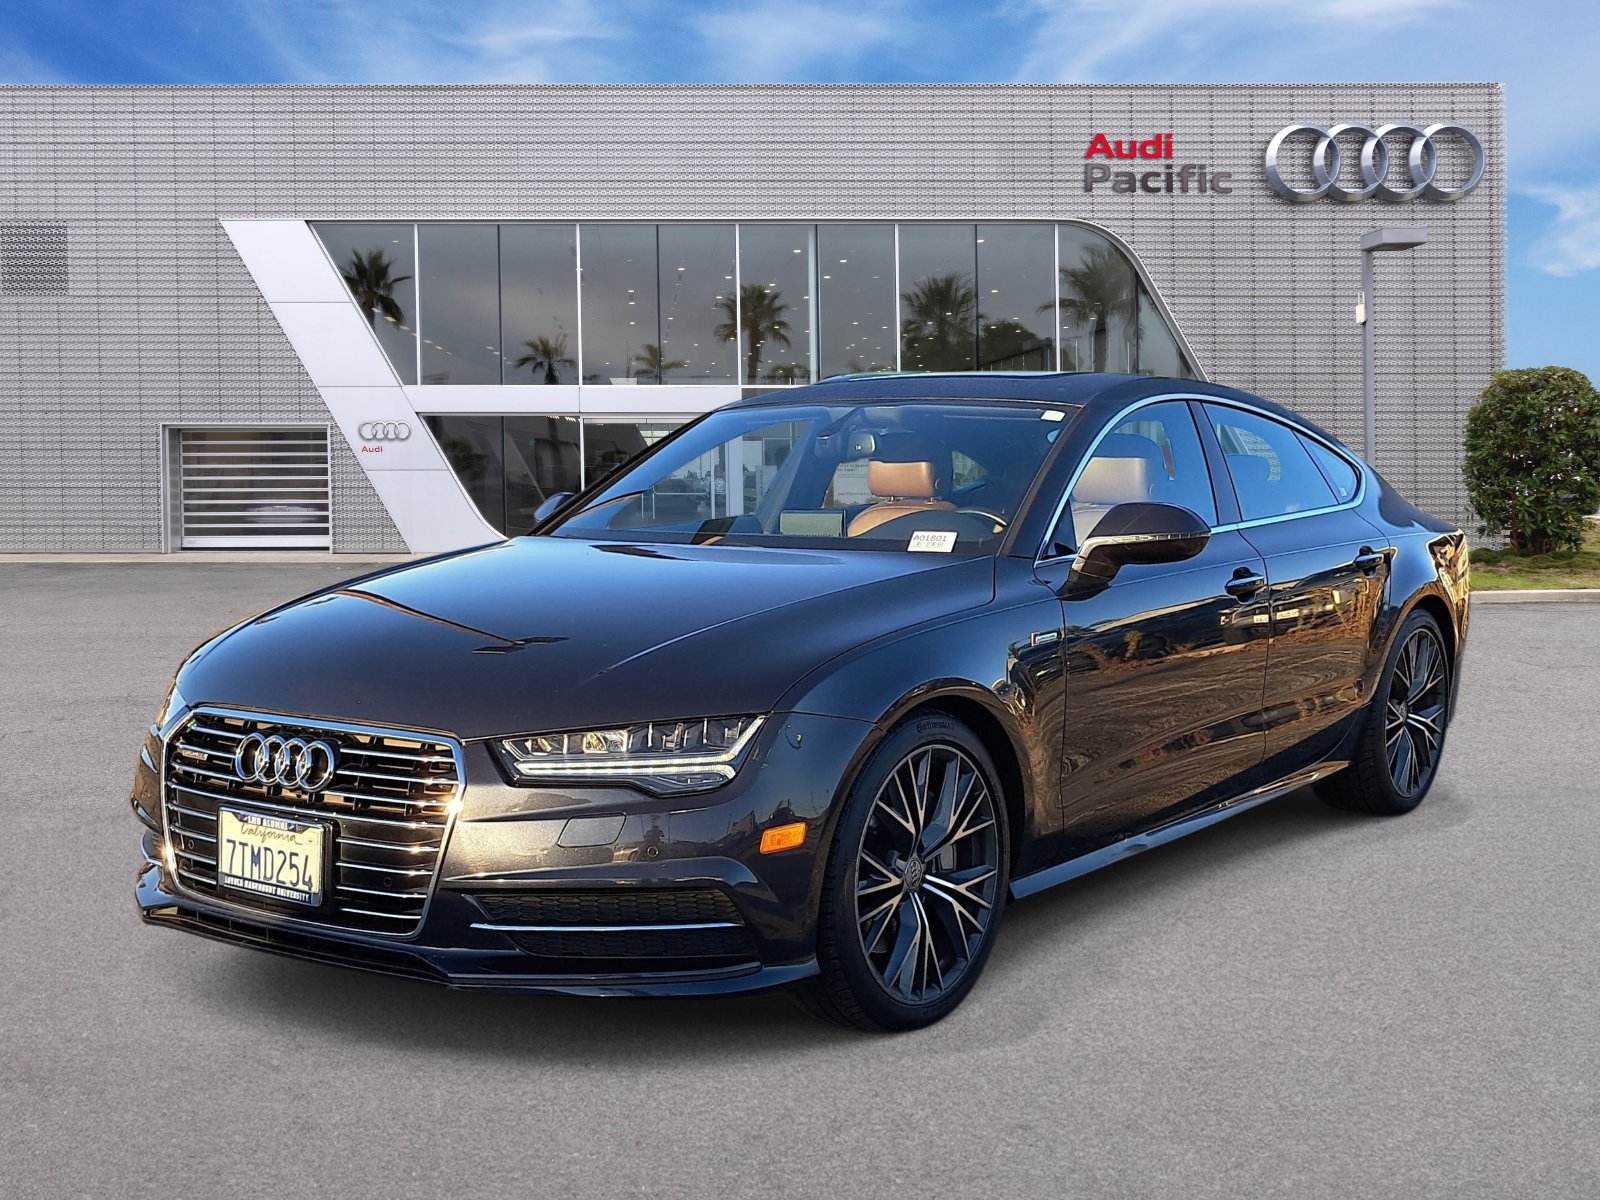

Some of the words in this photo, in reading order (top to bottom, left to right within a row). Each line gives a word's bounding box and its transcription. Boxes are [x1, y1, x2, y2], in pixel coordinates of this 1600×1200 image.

[1084, 133, 1173, 159] Audi
[1084, 163, 1233, 194] Pacific
[240, 823, 303, 845] California
[226, 838, 313, 891] 7TMD254
[276, 885, 310, 902] UNIVERSITY
